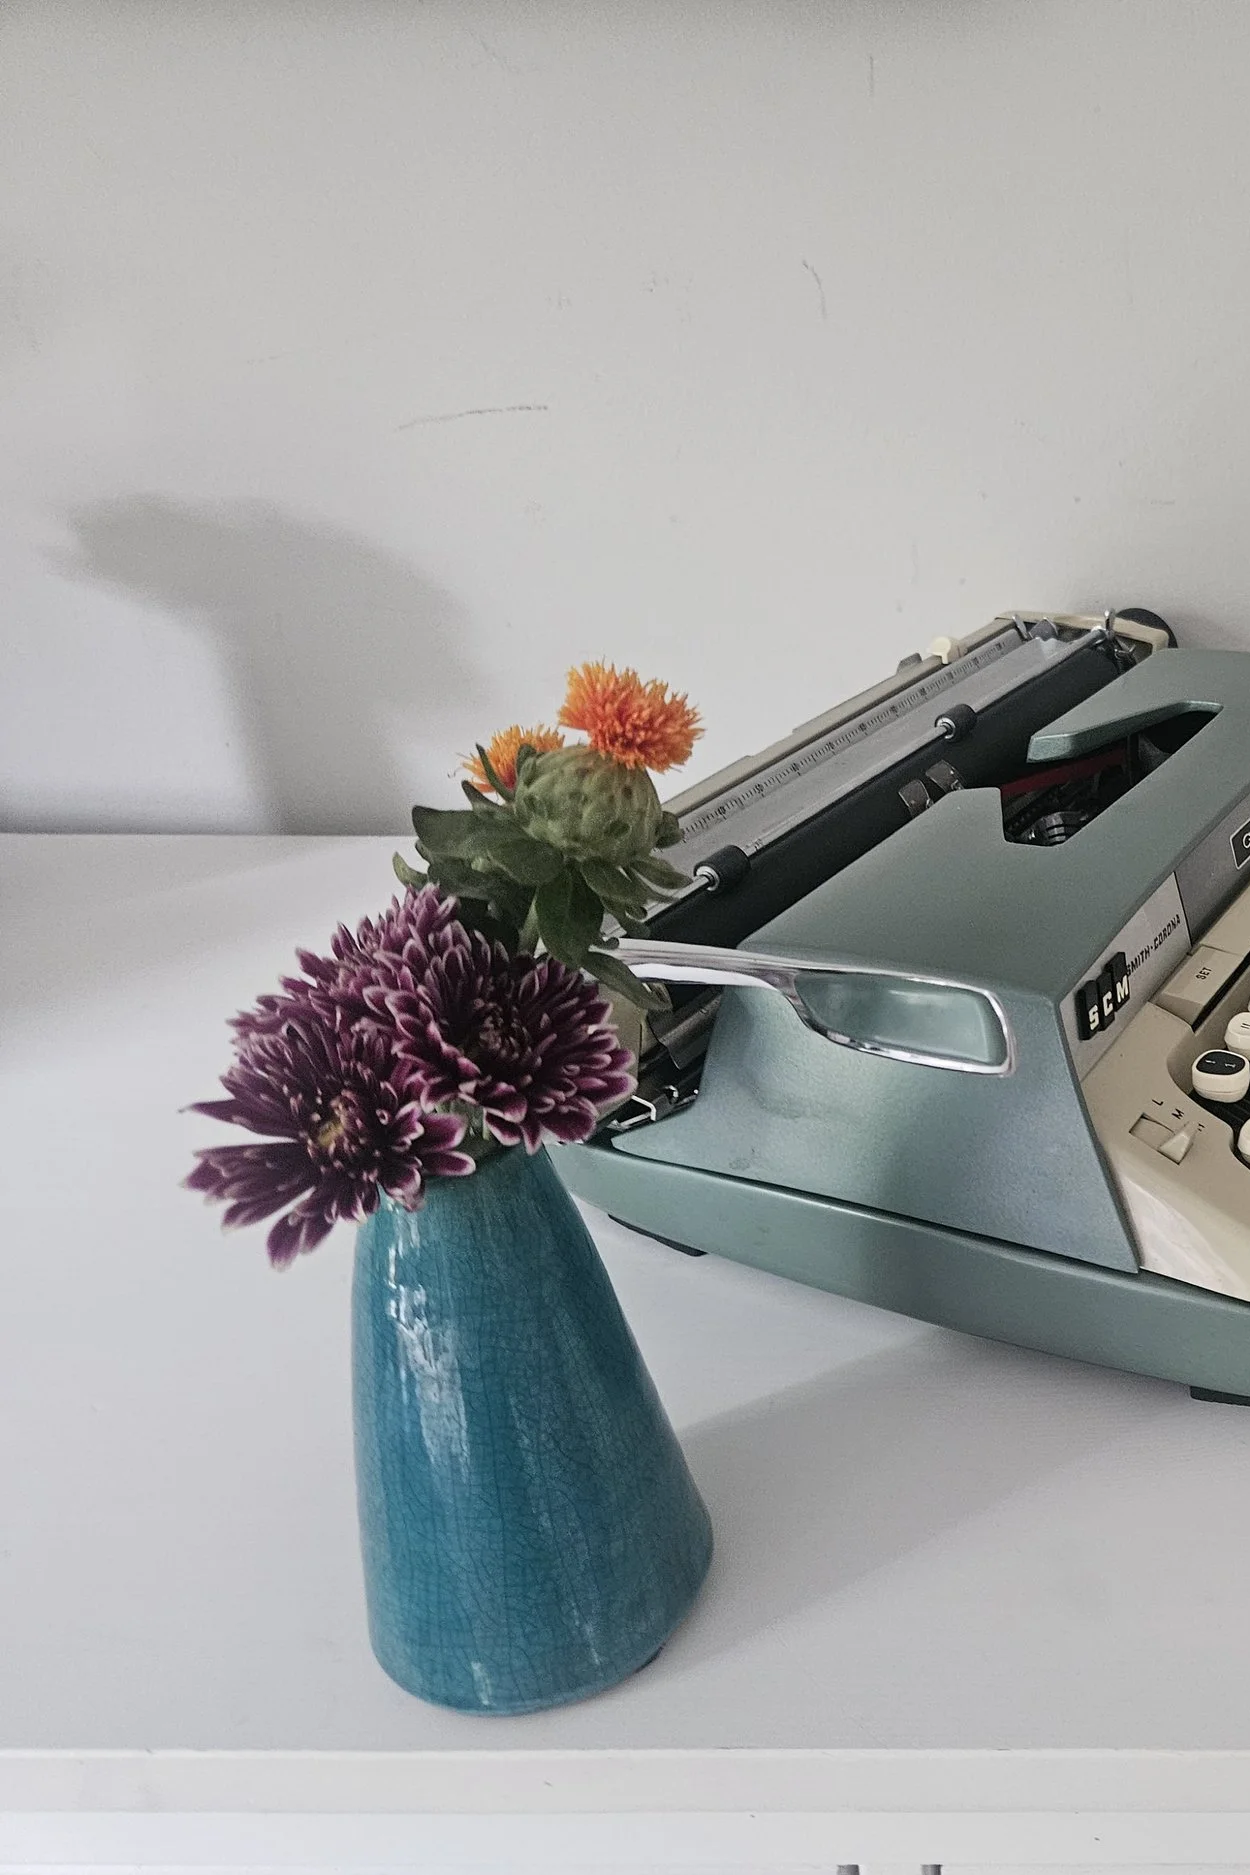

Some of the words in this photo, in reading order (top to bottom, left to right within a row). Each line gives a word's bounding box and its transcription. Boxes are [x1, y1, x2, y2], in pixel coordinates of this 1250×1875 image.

[1196, 967, 1211, 980] SET
[1088, 974, 1130, 1031] SCM
[1172, 1109, 1184, 1120] M
